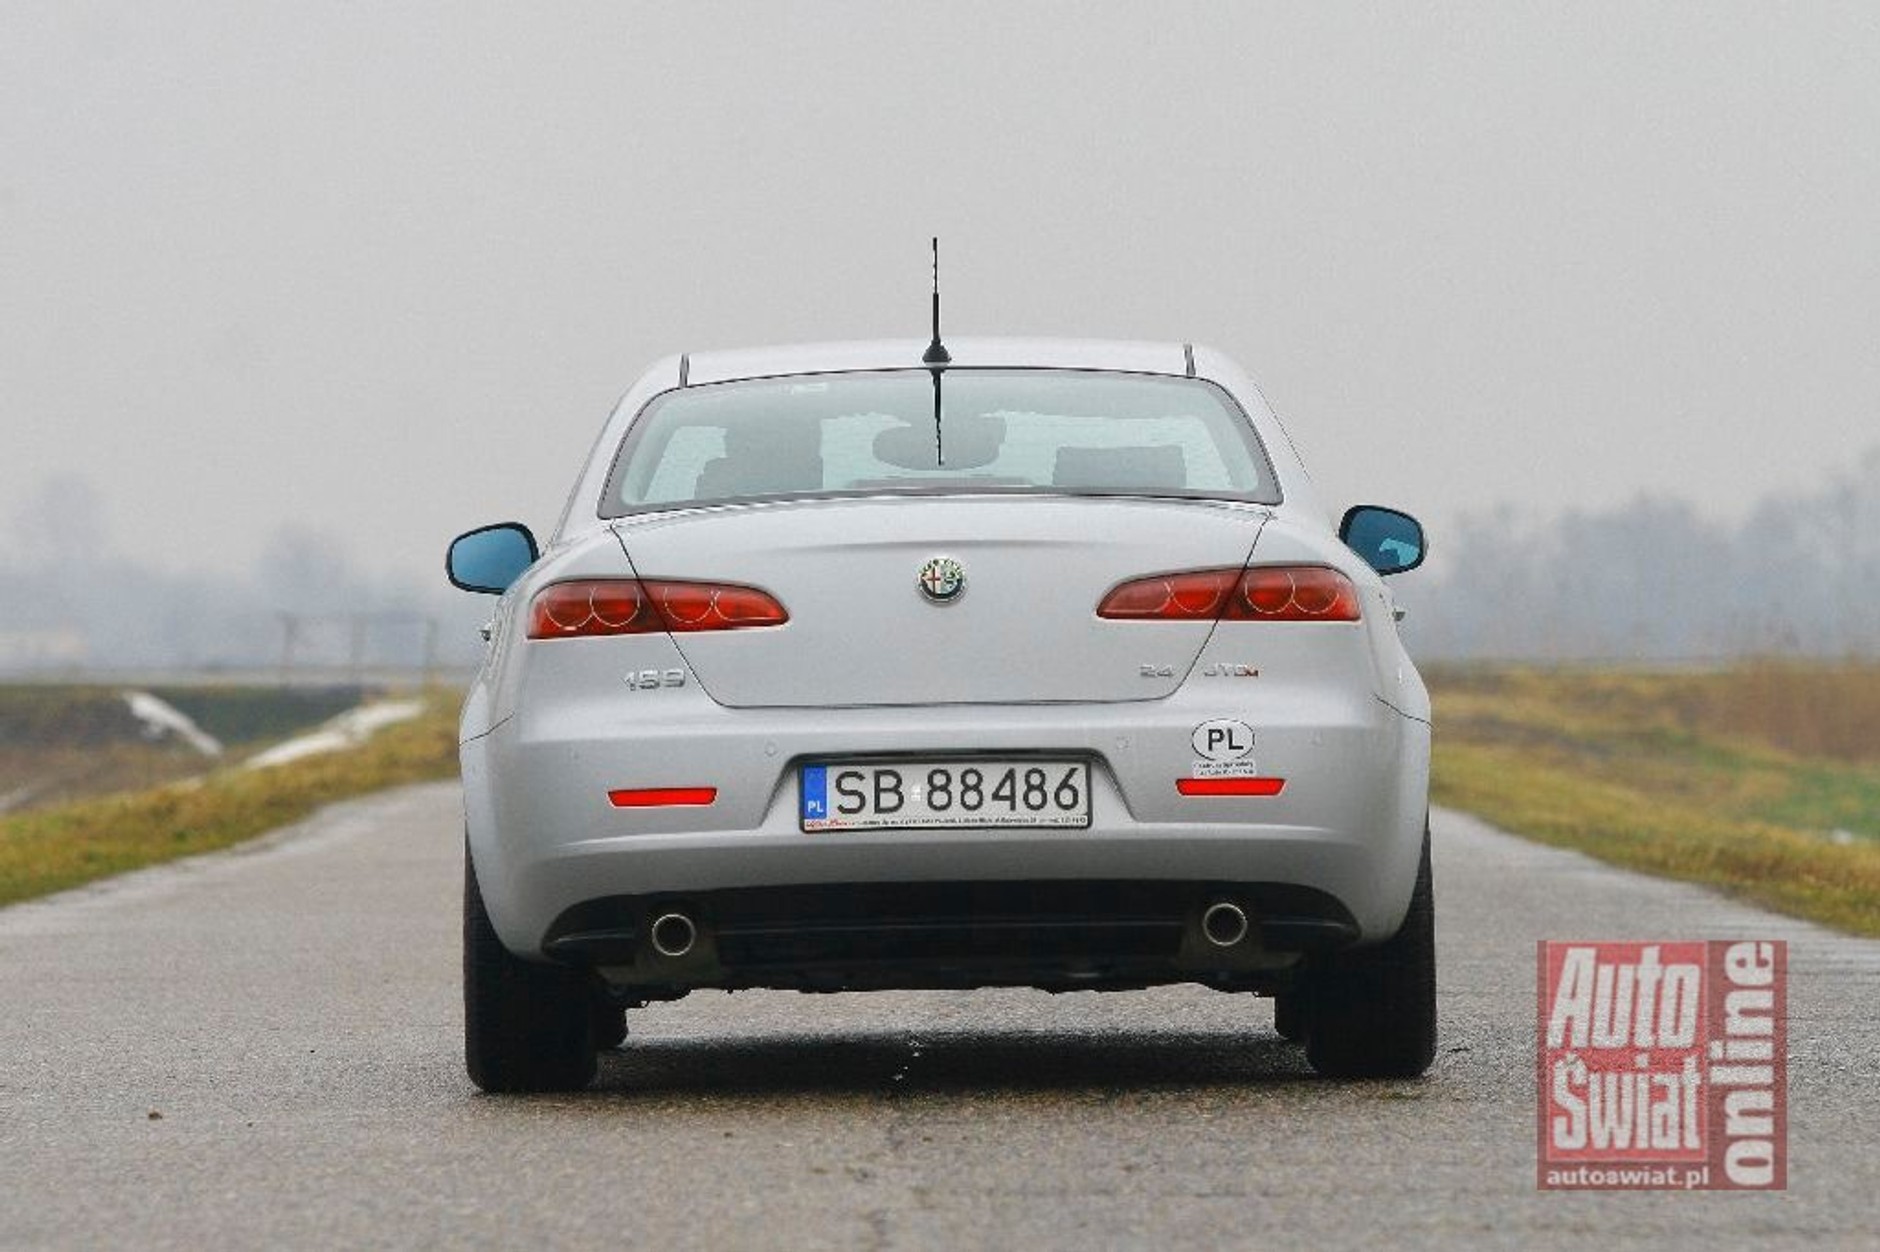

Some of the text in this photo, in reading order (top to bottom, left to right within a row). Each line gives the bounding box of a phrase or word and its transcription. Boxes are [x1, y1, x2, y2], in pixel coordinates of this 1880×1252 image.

[622, 669, 685, 691] 159
[1208, 728, 1244, 751] PL
[835, 767, 1079, 815] SB 88486
[807, 802, 824, 814] PL
